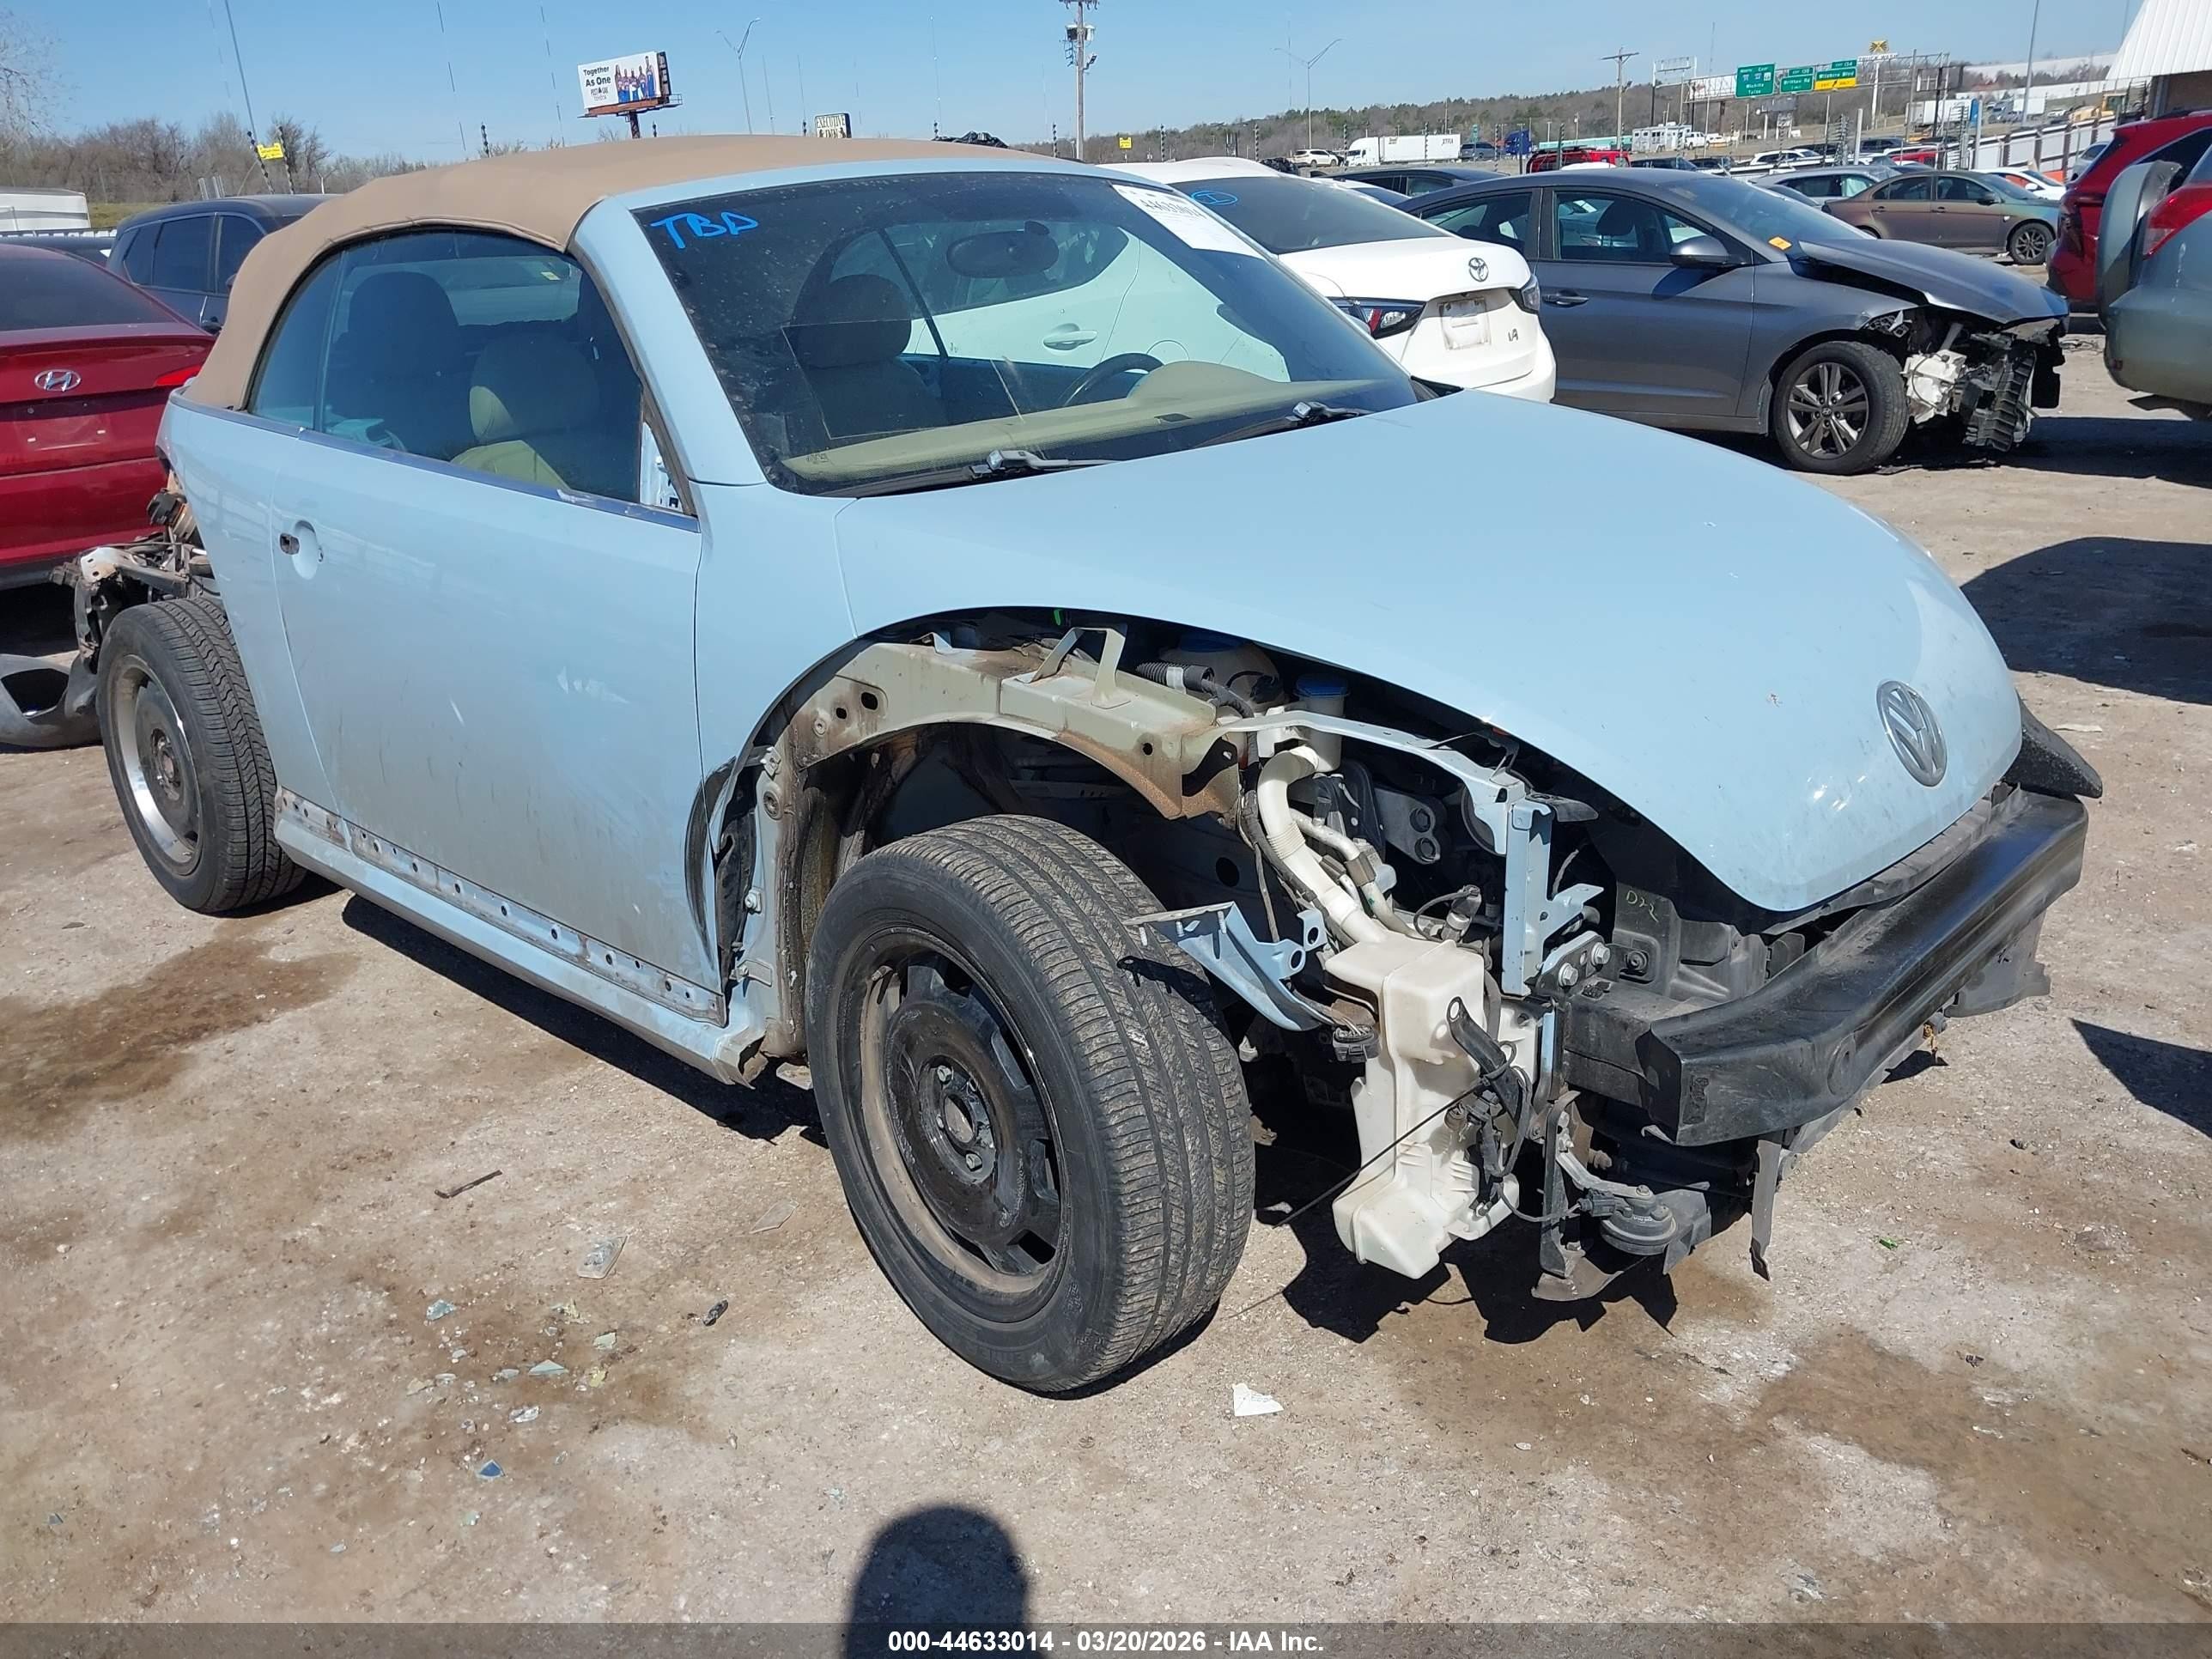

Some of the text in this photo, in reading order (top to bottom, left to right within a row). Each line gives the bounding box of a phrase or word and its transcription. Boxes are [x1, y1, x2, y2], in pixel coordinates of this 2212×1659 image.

[583, 66, 610, 76] Together
[586, 76, 611, 88] As One
[816, 115, 845, 128] EXECUTIVE
[825, 129, 838, 138] INN
